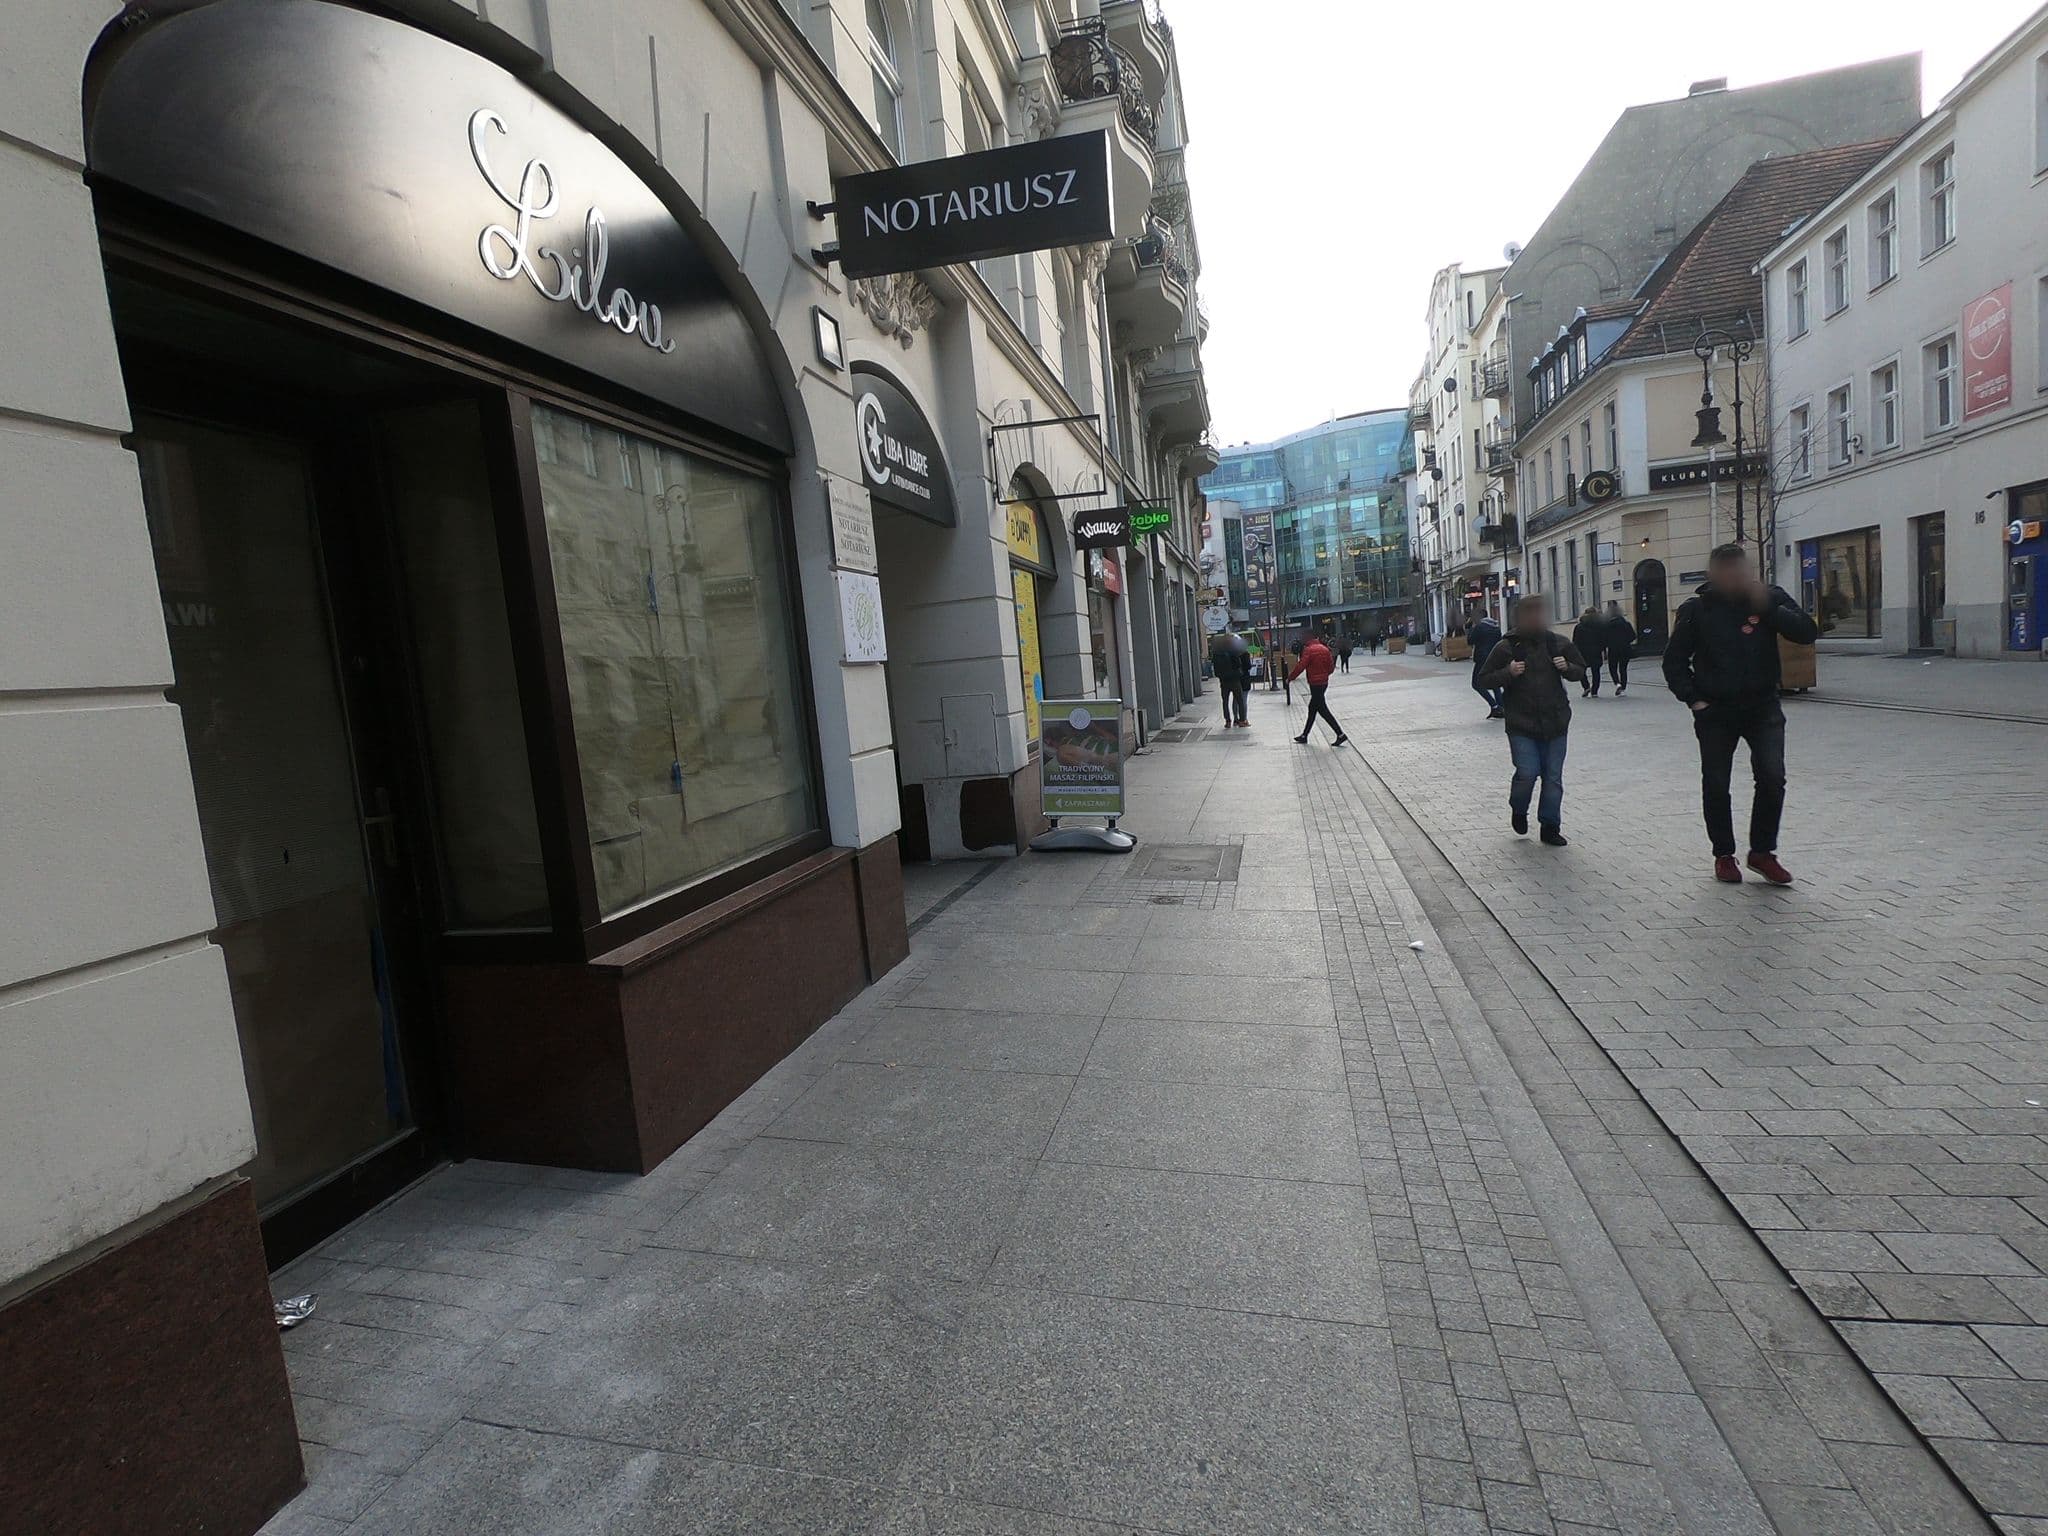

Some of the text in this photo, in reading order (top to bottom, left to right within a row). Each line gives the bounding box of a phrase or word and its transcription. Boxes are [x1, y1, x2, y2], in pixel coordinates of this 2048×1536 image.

[863, 168, 1080, 238] NOTARIUSZ
[467, 108, 676, 354] Lilou
[905, 445, 929, 477] LIBRE
[1661, 471, 1696, 482] KLUB
